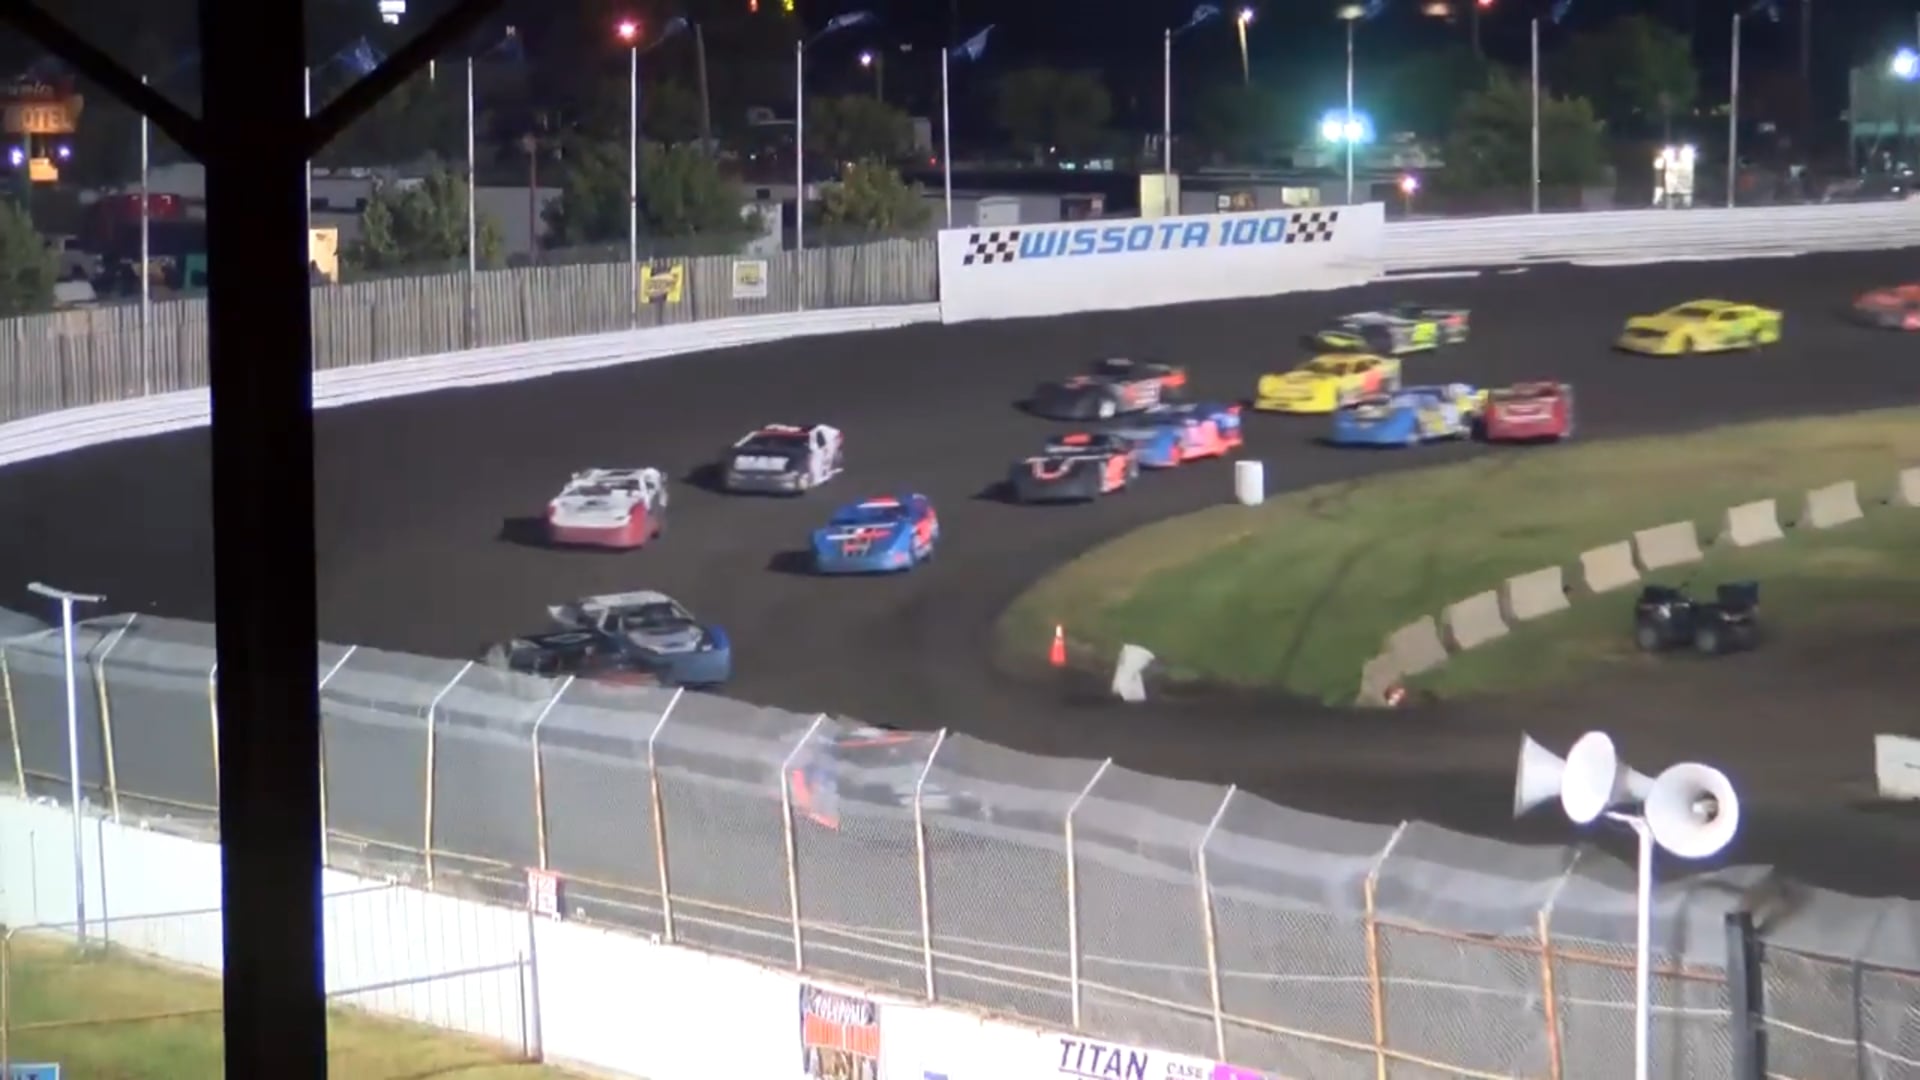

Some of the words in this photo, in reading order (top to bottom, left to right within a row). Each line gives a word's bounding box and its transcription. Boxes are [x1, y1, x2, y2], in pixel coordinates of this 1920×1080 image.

[9, 104, 75, 132] OTEL
[1019, 221, 1210, 259] WISSOTA
[1219, 216, 1287, 247] 100
[1060, 1038, 1148, 1080] TITAN
